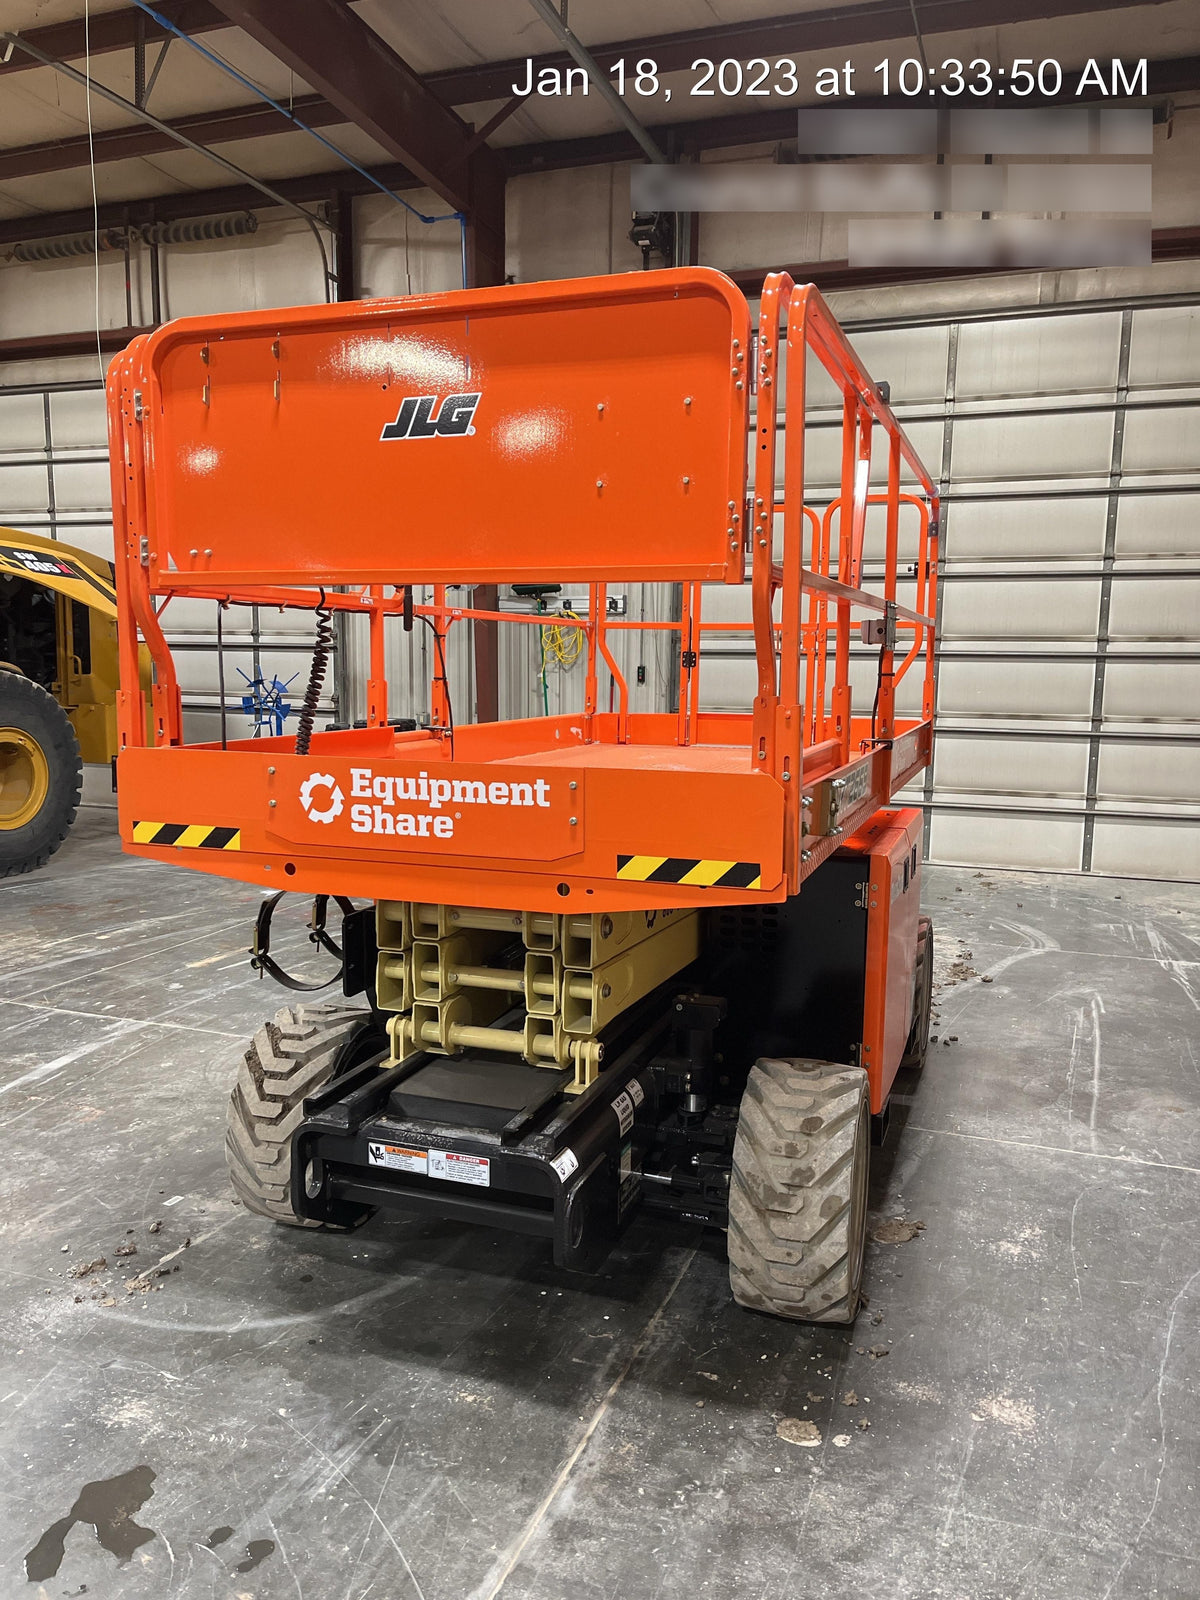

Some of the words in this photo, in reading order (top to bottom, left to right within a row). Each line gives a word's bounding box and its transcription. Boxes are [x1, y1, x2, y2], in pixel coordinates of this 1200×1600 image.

[380, 393, 482, 440] JLG
[350, 768, 550, 808] Equipment
[350, 804, 454, 838] Share
[397, 1147, 421, 1158] WARNING
[458, 1156, 481, 1164] DANGER
